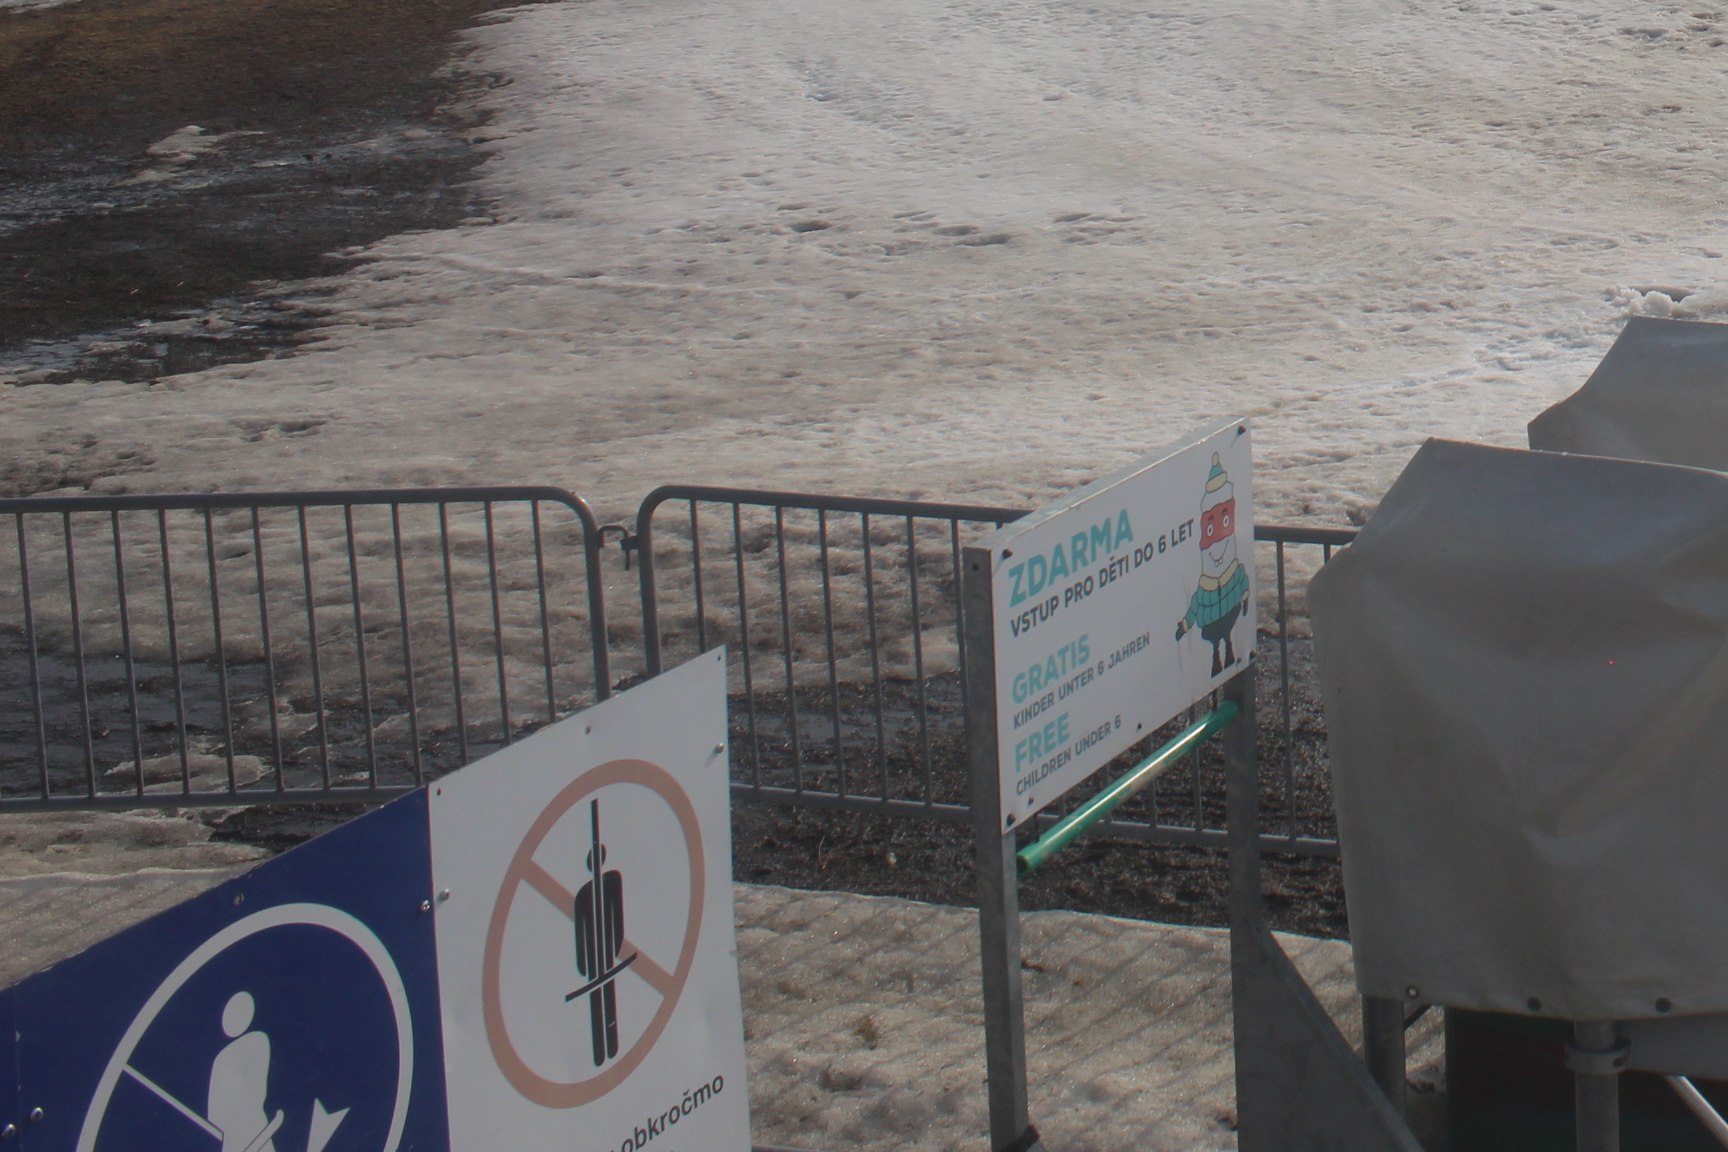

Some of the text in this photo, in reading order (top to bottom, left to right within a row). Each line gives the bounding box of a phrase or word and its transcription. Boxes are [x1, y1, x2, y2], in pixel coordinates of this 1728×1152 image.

[1008, 508, 1134, 608] ZDARMA
[1010, 518, 1194, 637] VSTUP PRO DĚTI DO 6 LET
[1012, 633, 1090, 705] GRATIS
[1013, 631, 1150, 730] KINDER UNTER 6 JAHREN
[1015, 711, 1069, 774] FREE
[1016, 714, 1121, 796] CHILDREN UNDER 6
[621, 1075, 724, 1152] obkročmo
